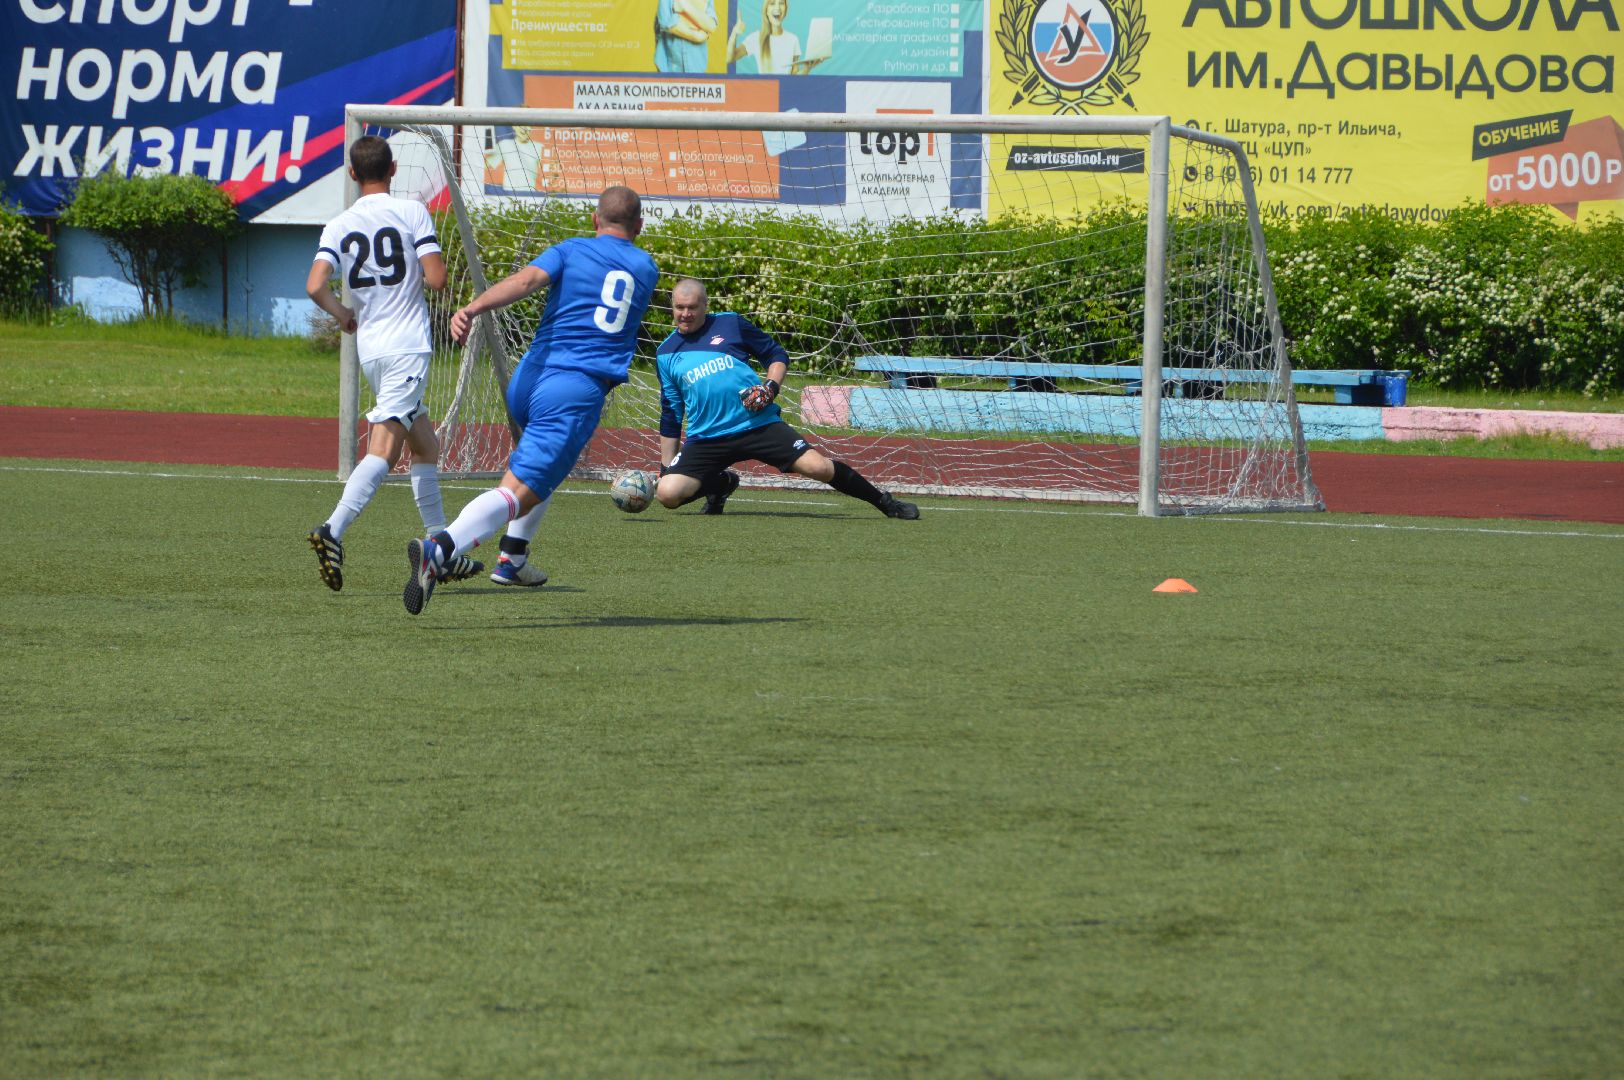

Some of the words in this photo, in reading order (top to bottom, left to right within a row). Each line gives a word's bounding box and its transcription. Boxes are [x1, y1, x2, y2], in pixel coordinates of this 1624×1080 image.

[867, 2, 929, 15] Разработка
[933, 4, 950, 14] ПО
[1182, 0, 1620, 32] АВТОШКОЛА
[511, 18, 608, 34] Преимущества:
[856, 17, 929, 29] Тестирование
[932, 18, 950, 29] ПО
[832, 32, 898, 44] мпьютерная
[900, 33, 949, 44] графика
[910, 46, 950, 57] дизайн
[884, 60, 919, 72] Python
[16, 46, 284, 120] норма
[576, 84, 620, 96] МАЛАЯ
[623, 84, 722, 99] КОМПЬЮТЕРНАЯ
[1225, 118, 1291, 137] Шатура,
[1297, 122, 1332, 138] пр-т
[1338, 120, 1402, 139] Ильича,
[1479, 119, 1560, 147] ОБУЧЕНИЕ
[555, 129, 634, 144] программе:
[12, 115, 311, 184] жизни!
[552, 147, 659, 161] Программирование
[678, 151, 754, 163] Робототехника
[1264, 141, 1312, 158] «ЦУП»
[1014, 151, 1120, 166] oz-avtoschool.ru
[709, 168, 717, 177] и
[860, 172, 935, 184] КОМПЬЮТЕРНАЯ
[1205, 165, 1214, 182] 8
[1222, 165, 1263, 186] (96)
[1269, 165, 1288, 183] 01
[1297, 166, 1316, 183] 14
[1323, 167, 1354, 184] 777
[861, 186, 910, 197] АКАДЕМИЯ
[340, 226, 407, 290] 29
[593, 270, 635, 334] 9
